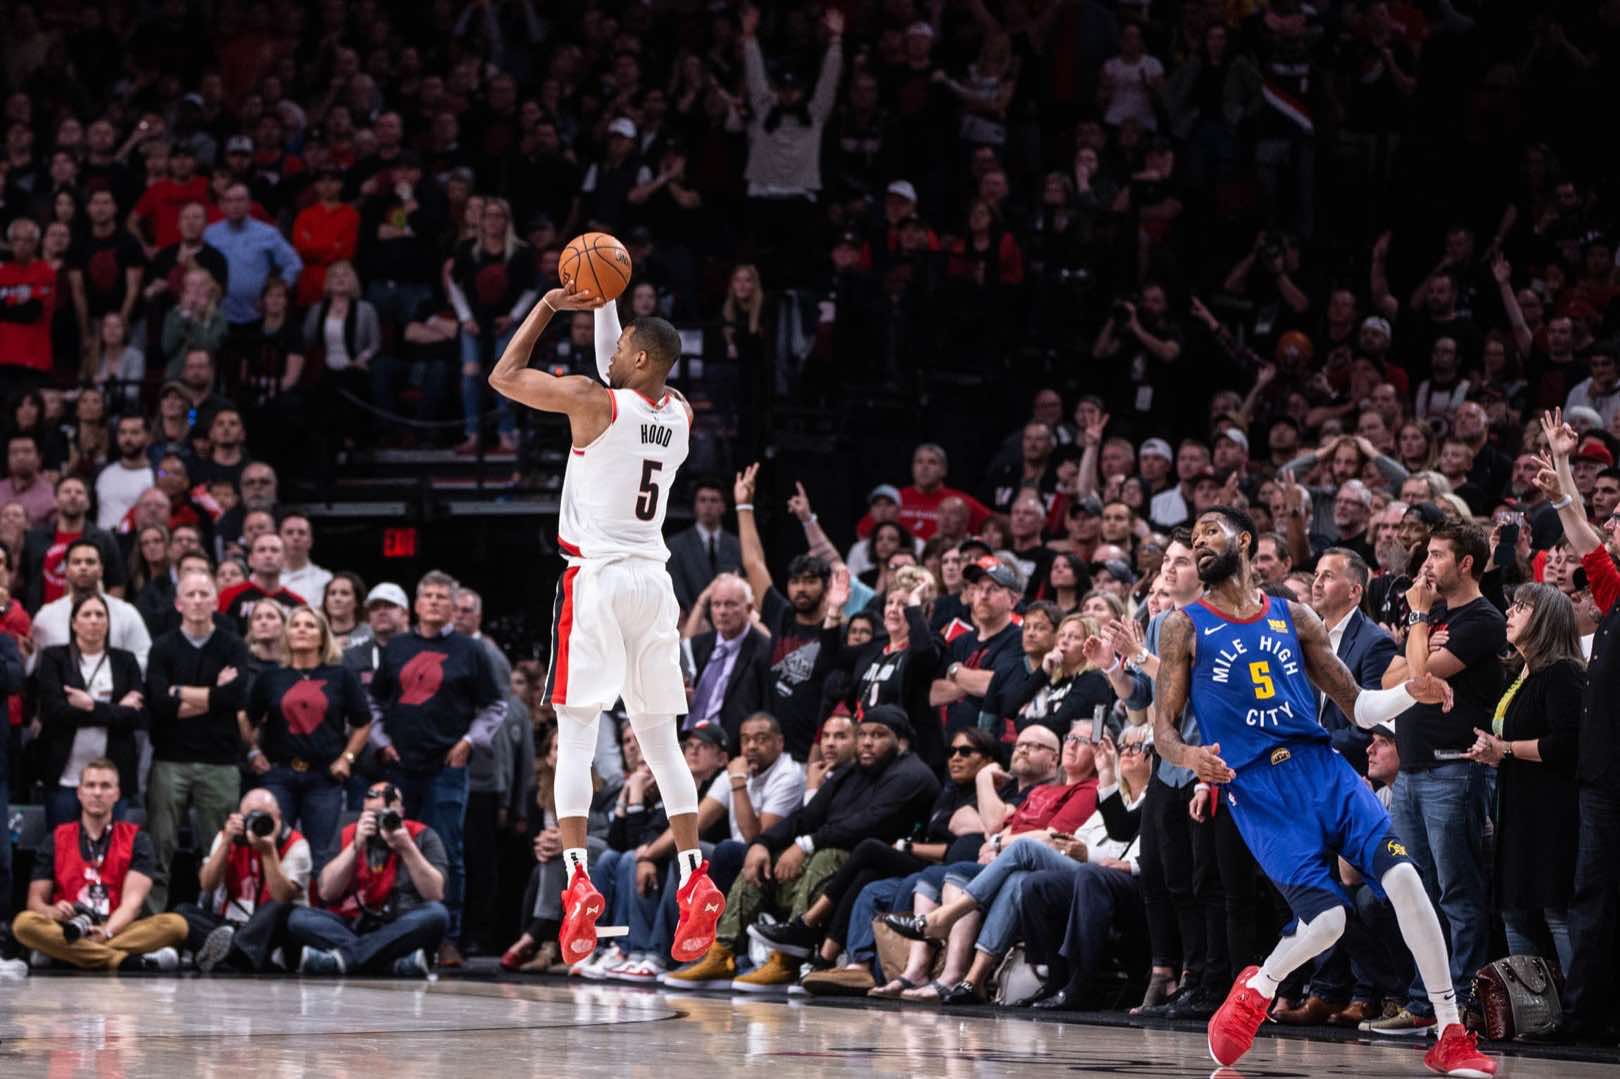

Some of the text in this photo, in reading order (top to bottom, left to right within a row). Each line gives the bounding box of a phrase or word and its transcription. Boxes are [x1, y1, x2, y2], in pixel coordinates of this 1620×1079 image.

[641, 424, 673, 448] HOOD
[635, 459, 663, 522] 5
[1212, 635, 1299, 683] MILE HIGH
[1248, 661, 1276, 700] 5
[1246, 701, 1294, 727] CITY
